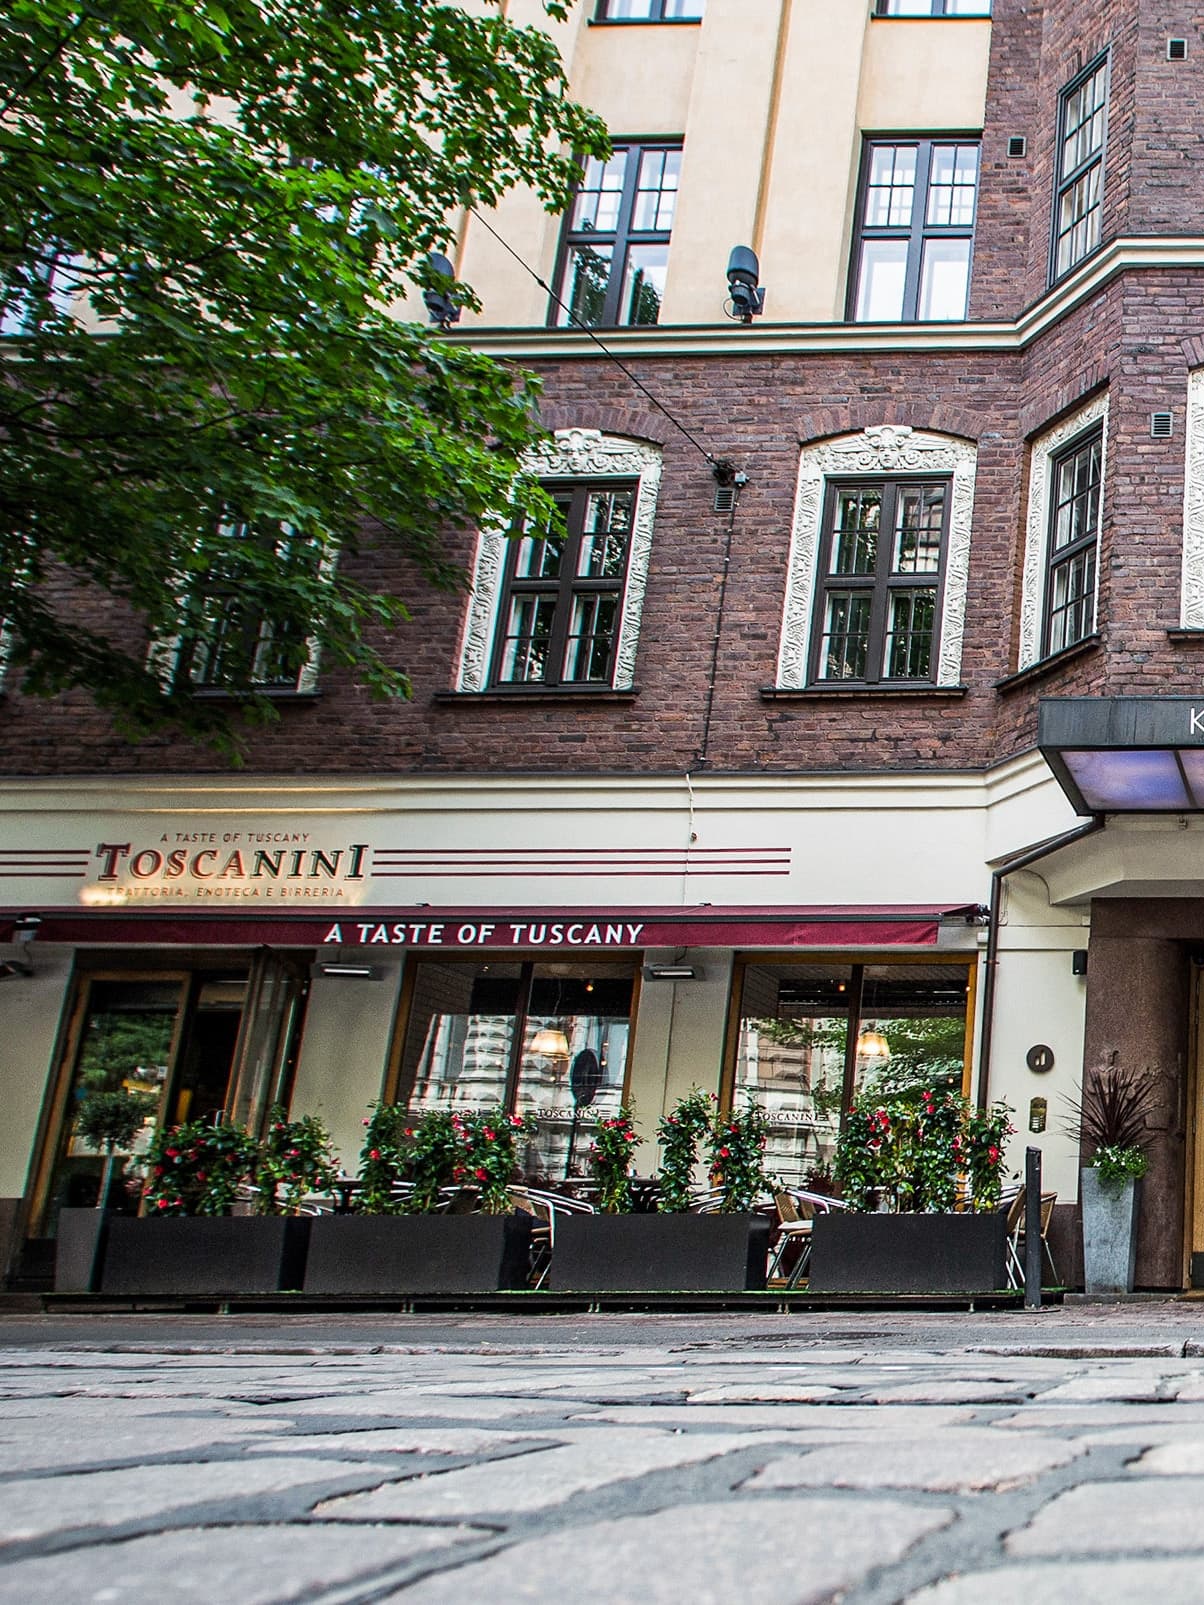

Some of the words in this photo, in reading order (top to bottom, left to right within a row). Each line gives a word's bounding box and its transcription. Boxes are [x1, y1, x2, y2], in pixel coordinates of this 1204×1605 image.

[160, 833, 168, 842] A
[175, 833, 217, 842] TASTE
[222, 833, 242, 843] OF
[248, 832, 311, 842] TUSCANY
[96, 842, 369, 881] TOSCANINI
[196, 887, 260, 897] ENOTECA
[265, 887, 273, 897] E
[280, 887, 344, 897] BIRRERIA
[324, 923, 343, 944] A
[357, 923, 445, 944] TASTE
[457, 923, 496, 945] OF
[509, 923, 644, 944] TUSCANY
